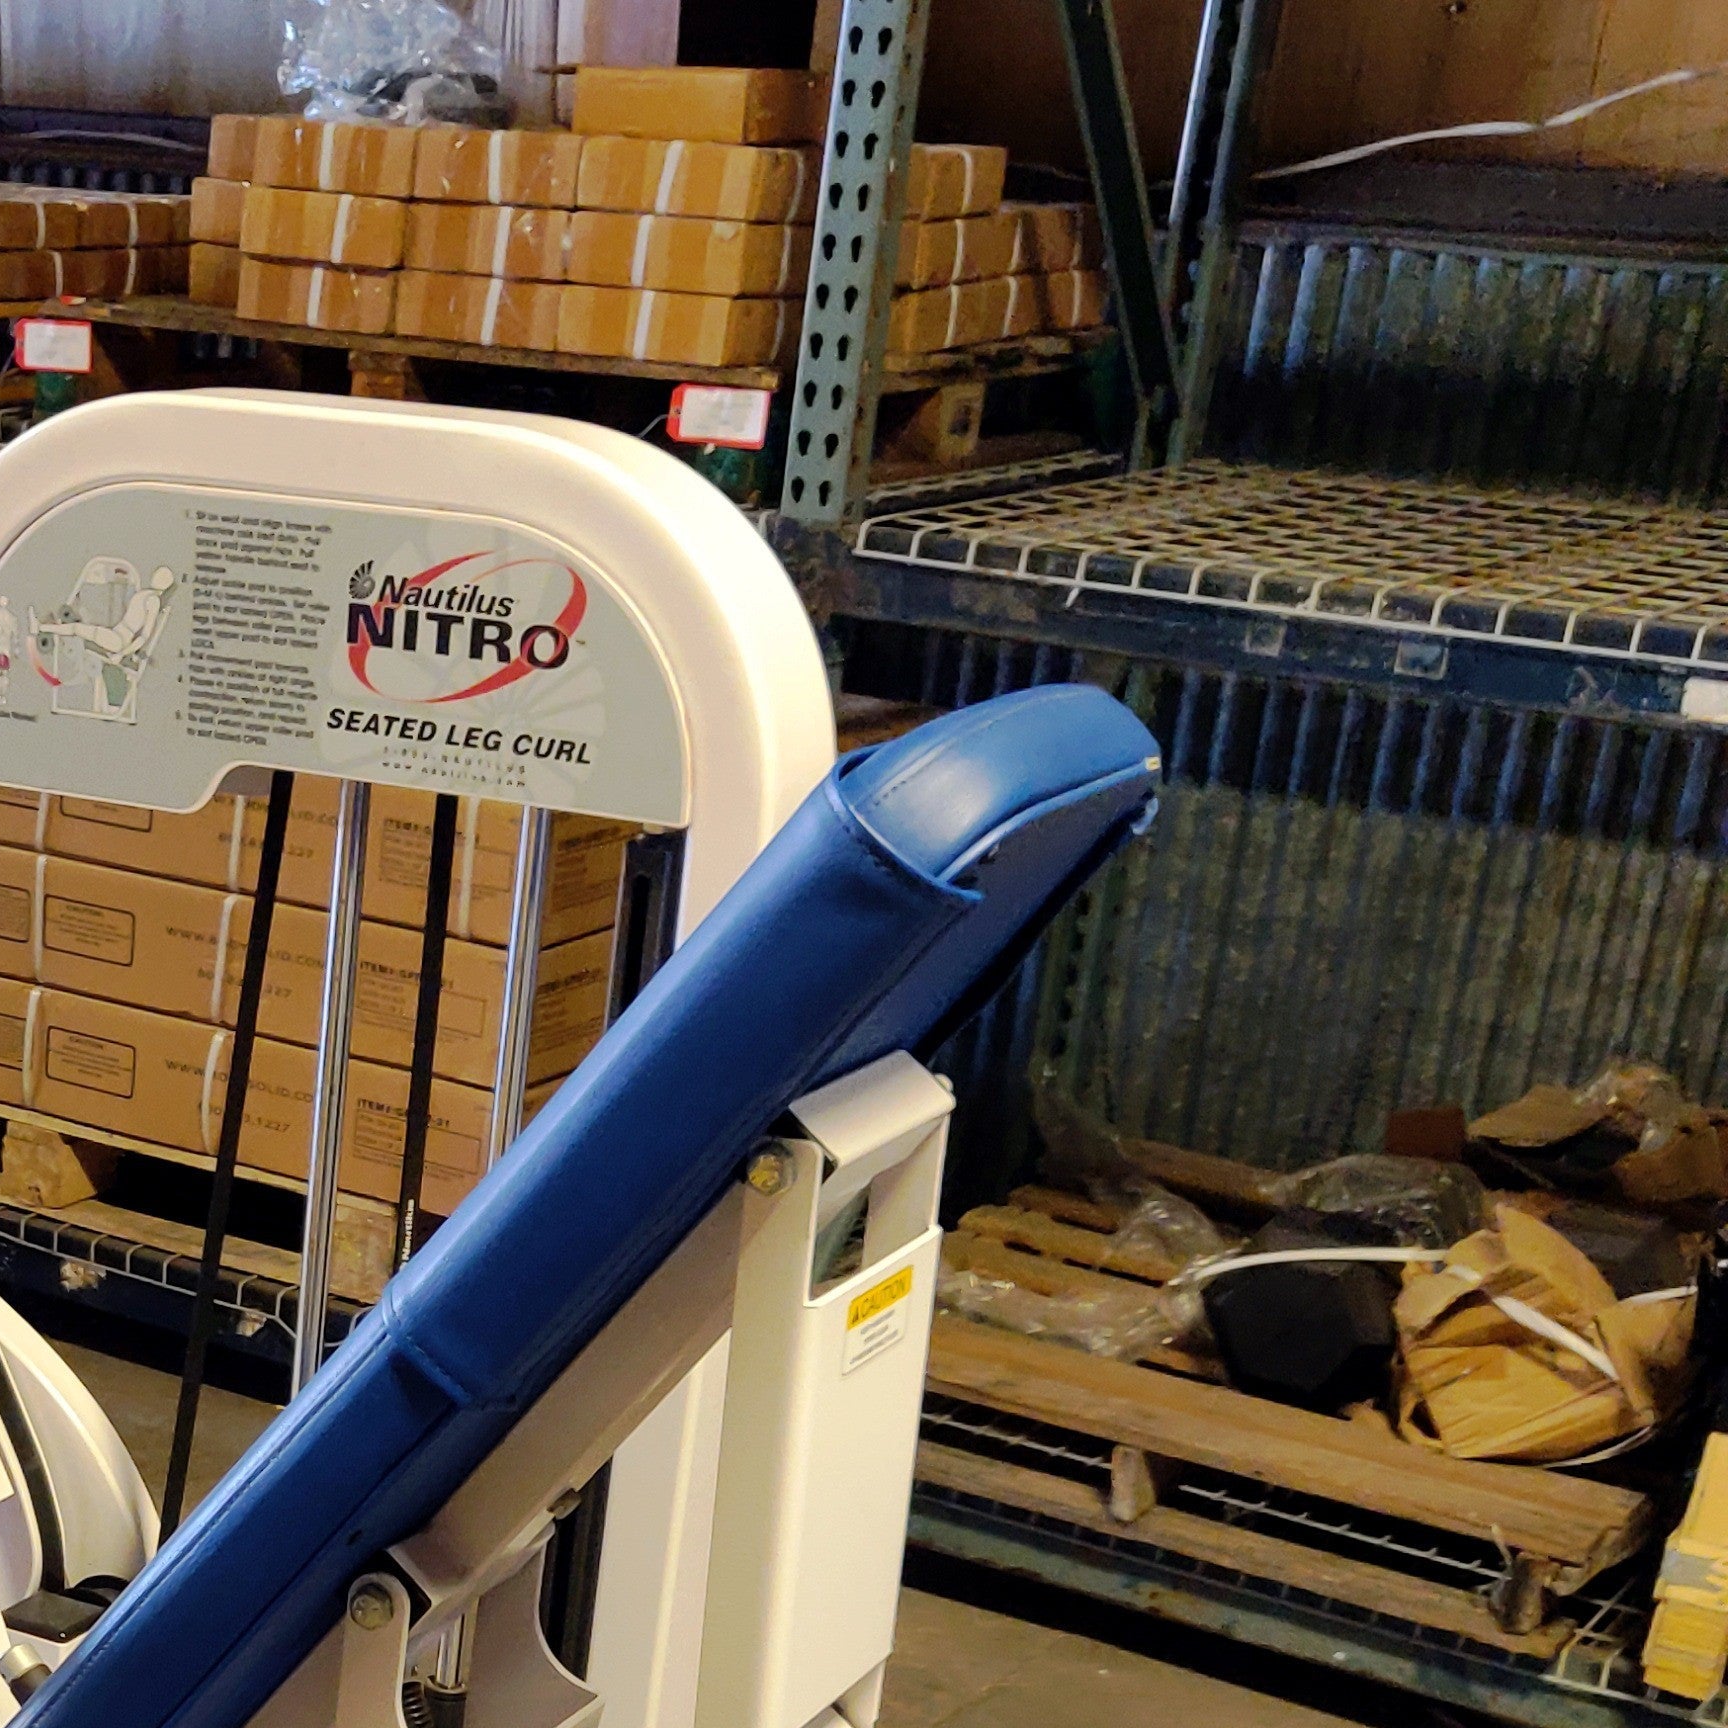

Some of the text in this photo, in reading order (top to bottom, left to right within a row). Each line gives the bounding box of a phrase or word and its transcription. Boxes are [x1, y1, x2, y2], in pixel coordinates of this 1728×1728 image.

[378, 574, 515, 617] Nautilus
[347, 602, 570, 670] NITRO
[326, 708, 591, 765] SEATED LEG CURL
